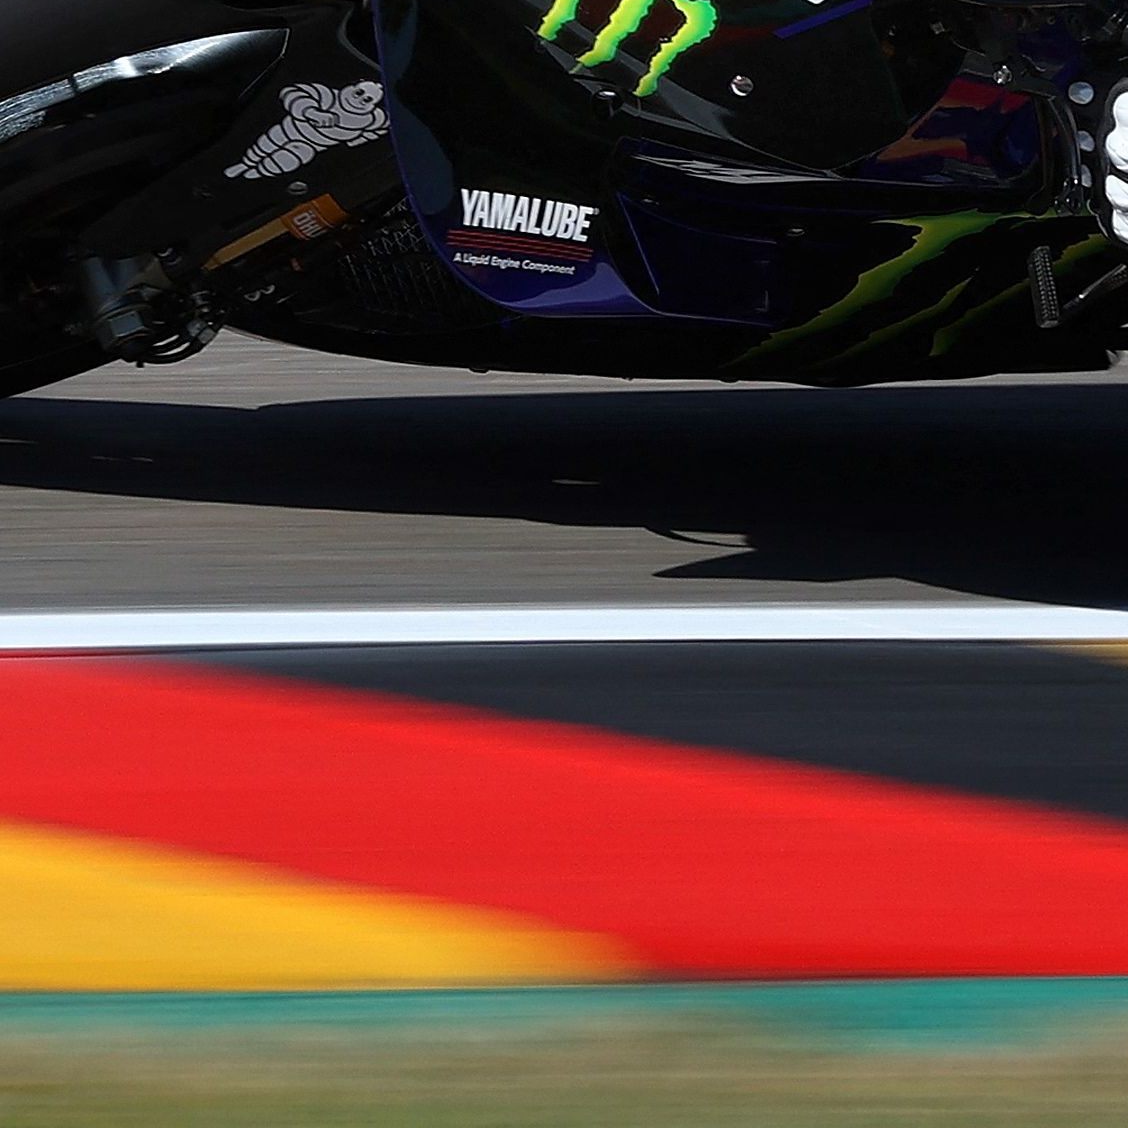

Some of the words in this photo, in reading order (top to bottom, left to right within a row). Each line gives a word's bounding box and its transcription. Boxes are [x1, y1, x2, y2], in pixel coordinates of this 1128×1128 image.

[460, 188, 594, 242] YAMALUBE
[453, 252, 462, 262] A
[463, 254, 490, 266] Liquid
[491, 256, 521, 270] Engine
[522, 259, 576, 275] Component
